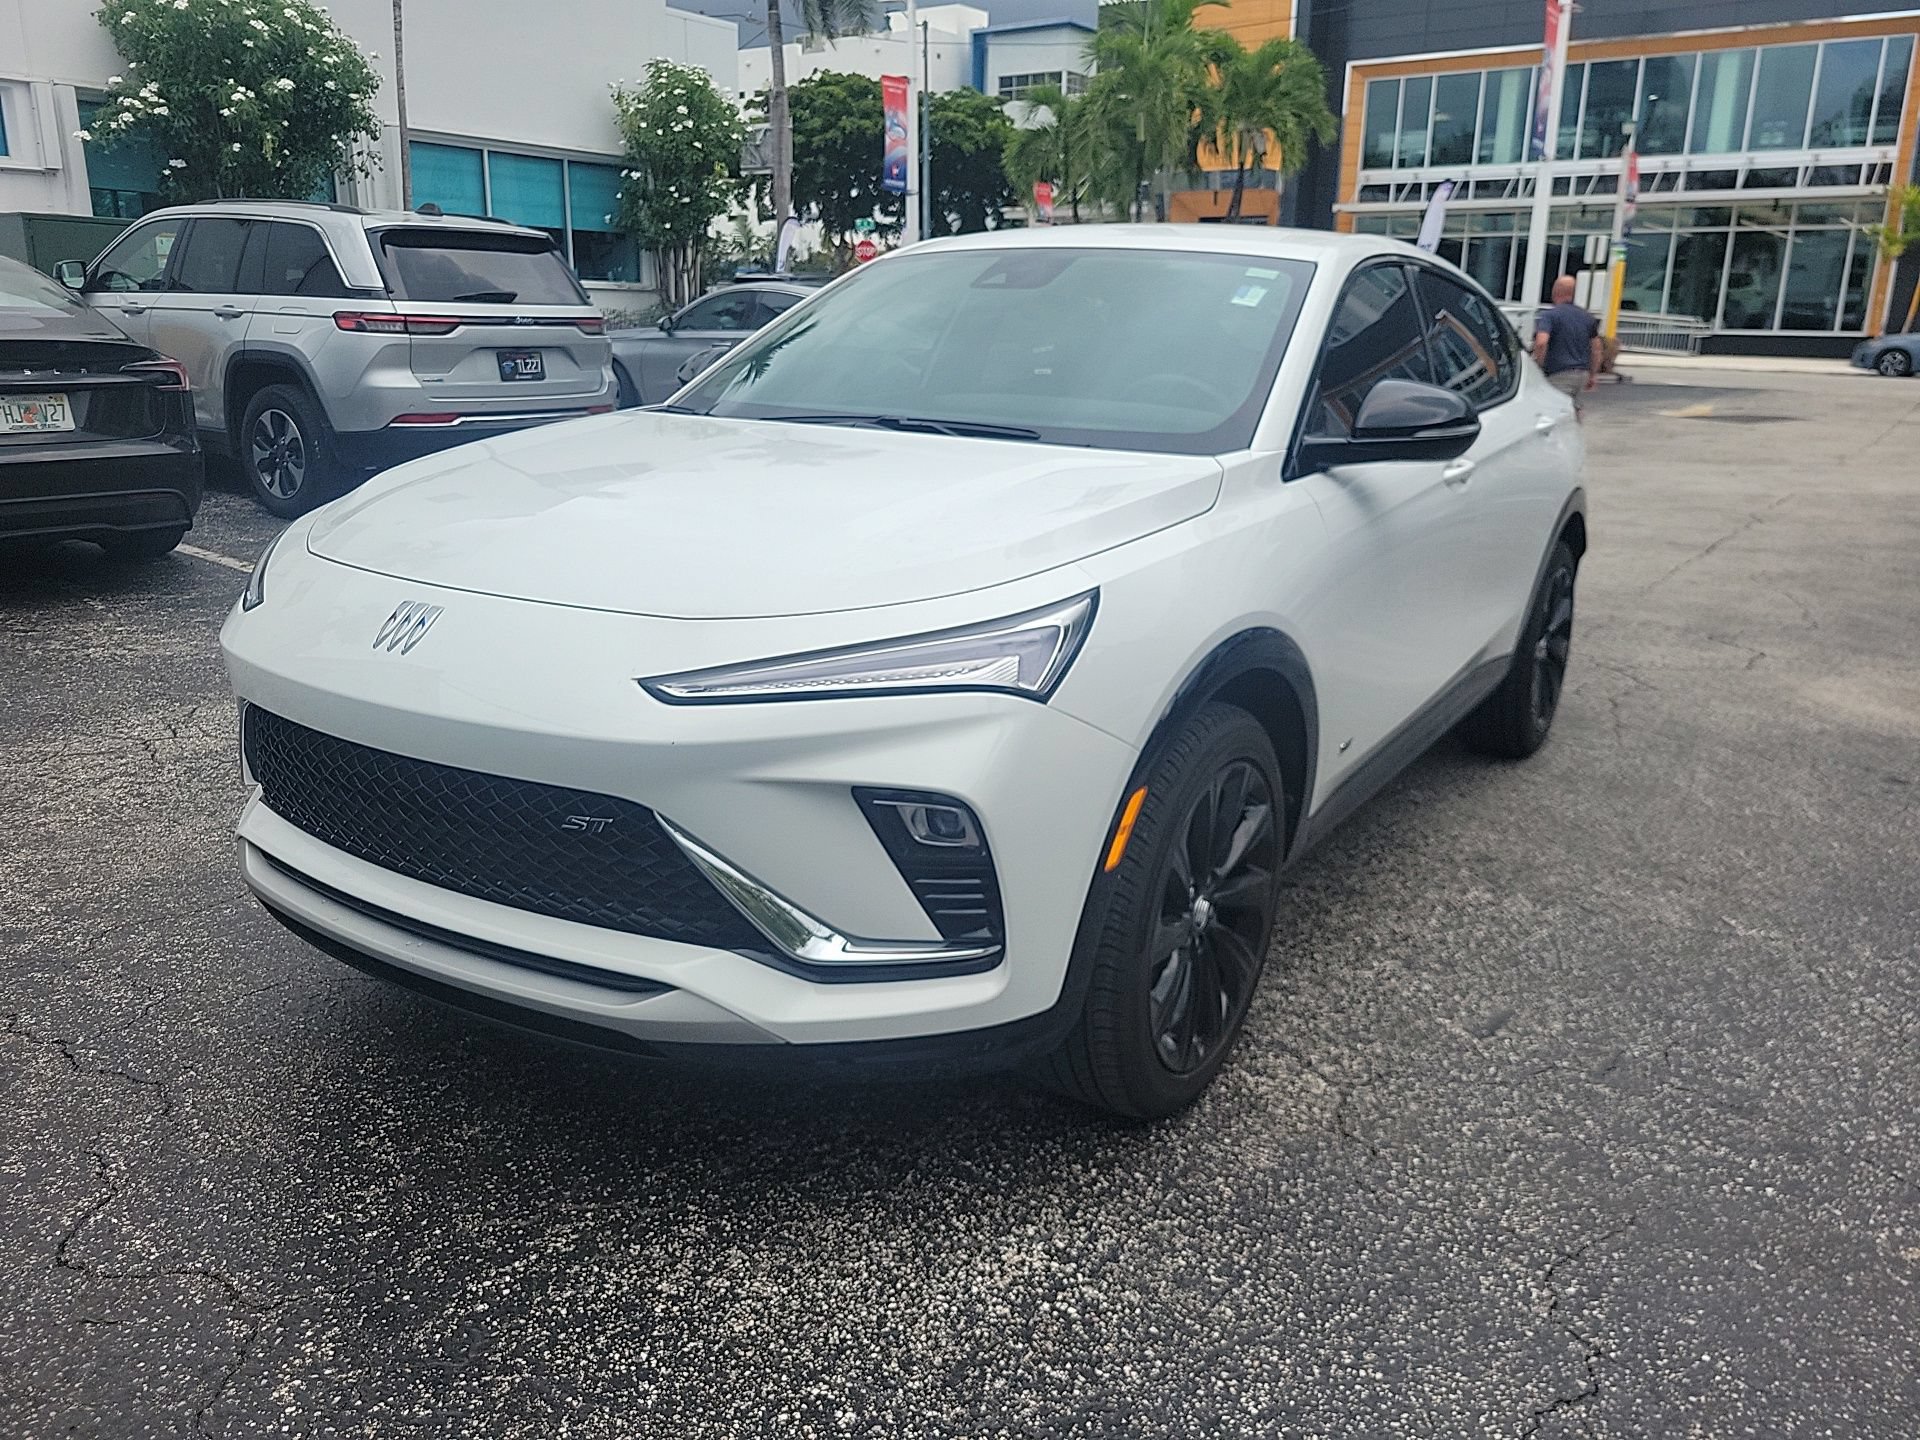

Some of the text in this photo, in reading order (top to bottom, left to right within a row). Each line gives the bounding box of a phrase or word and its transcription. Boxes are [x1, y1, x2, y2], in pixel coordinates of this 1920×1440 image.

[855, 246, 876, 257] STOP
[0, 404, 23, 424] HJ
[561, 815, 614, 833] ST
